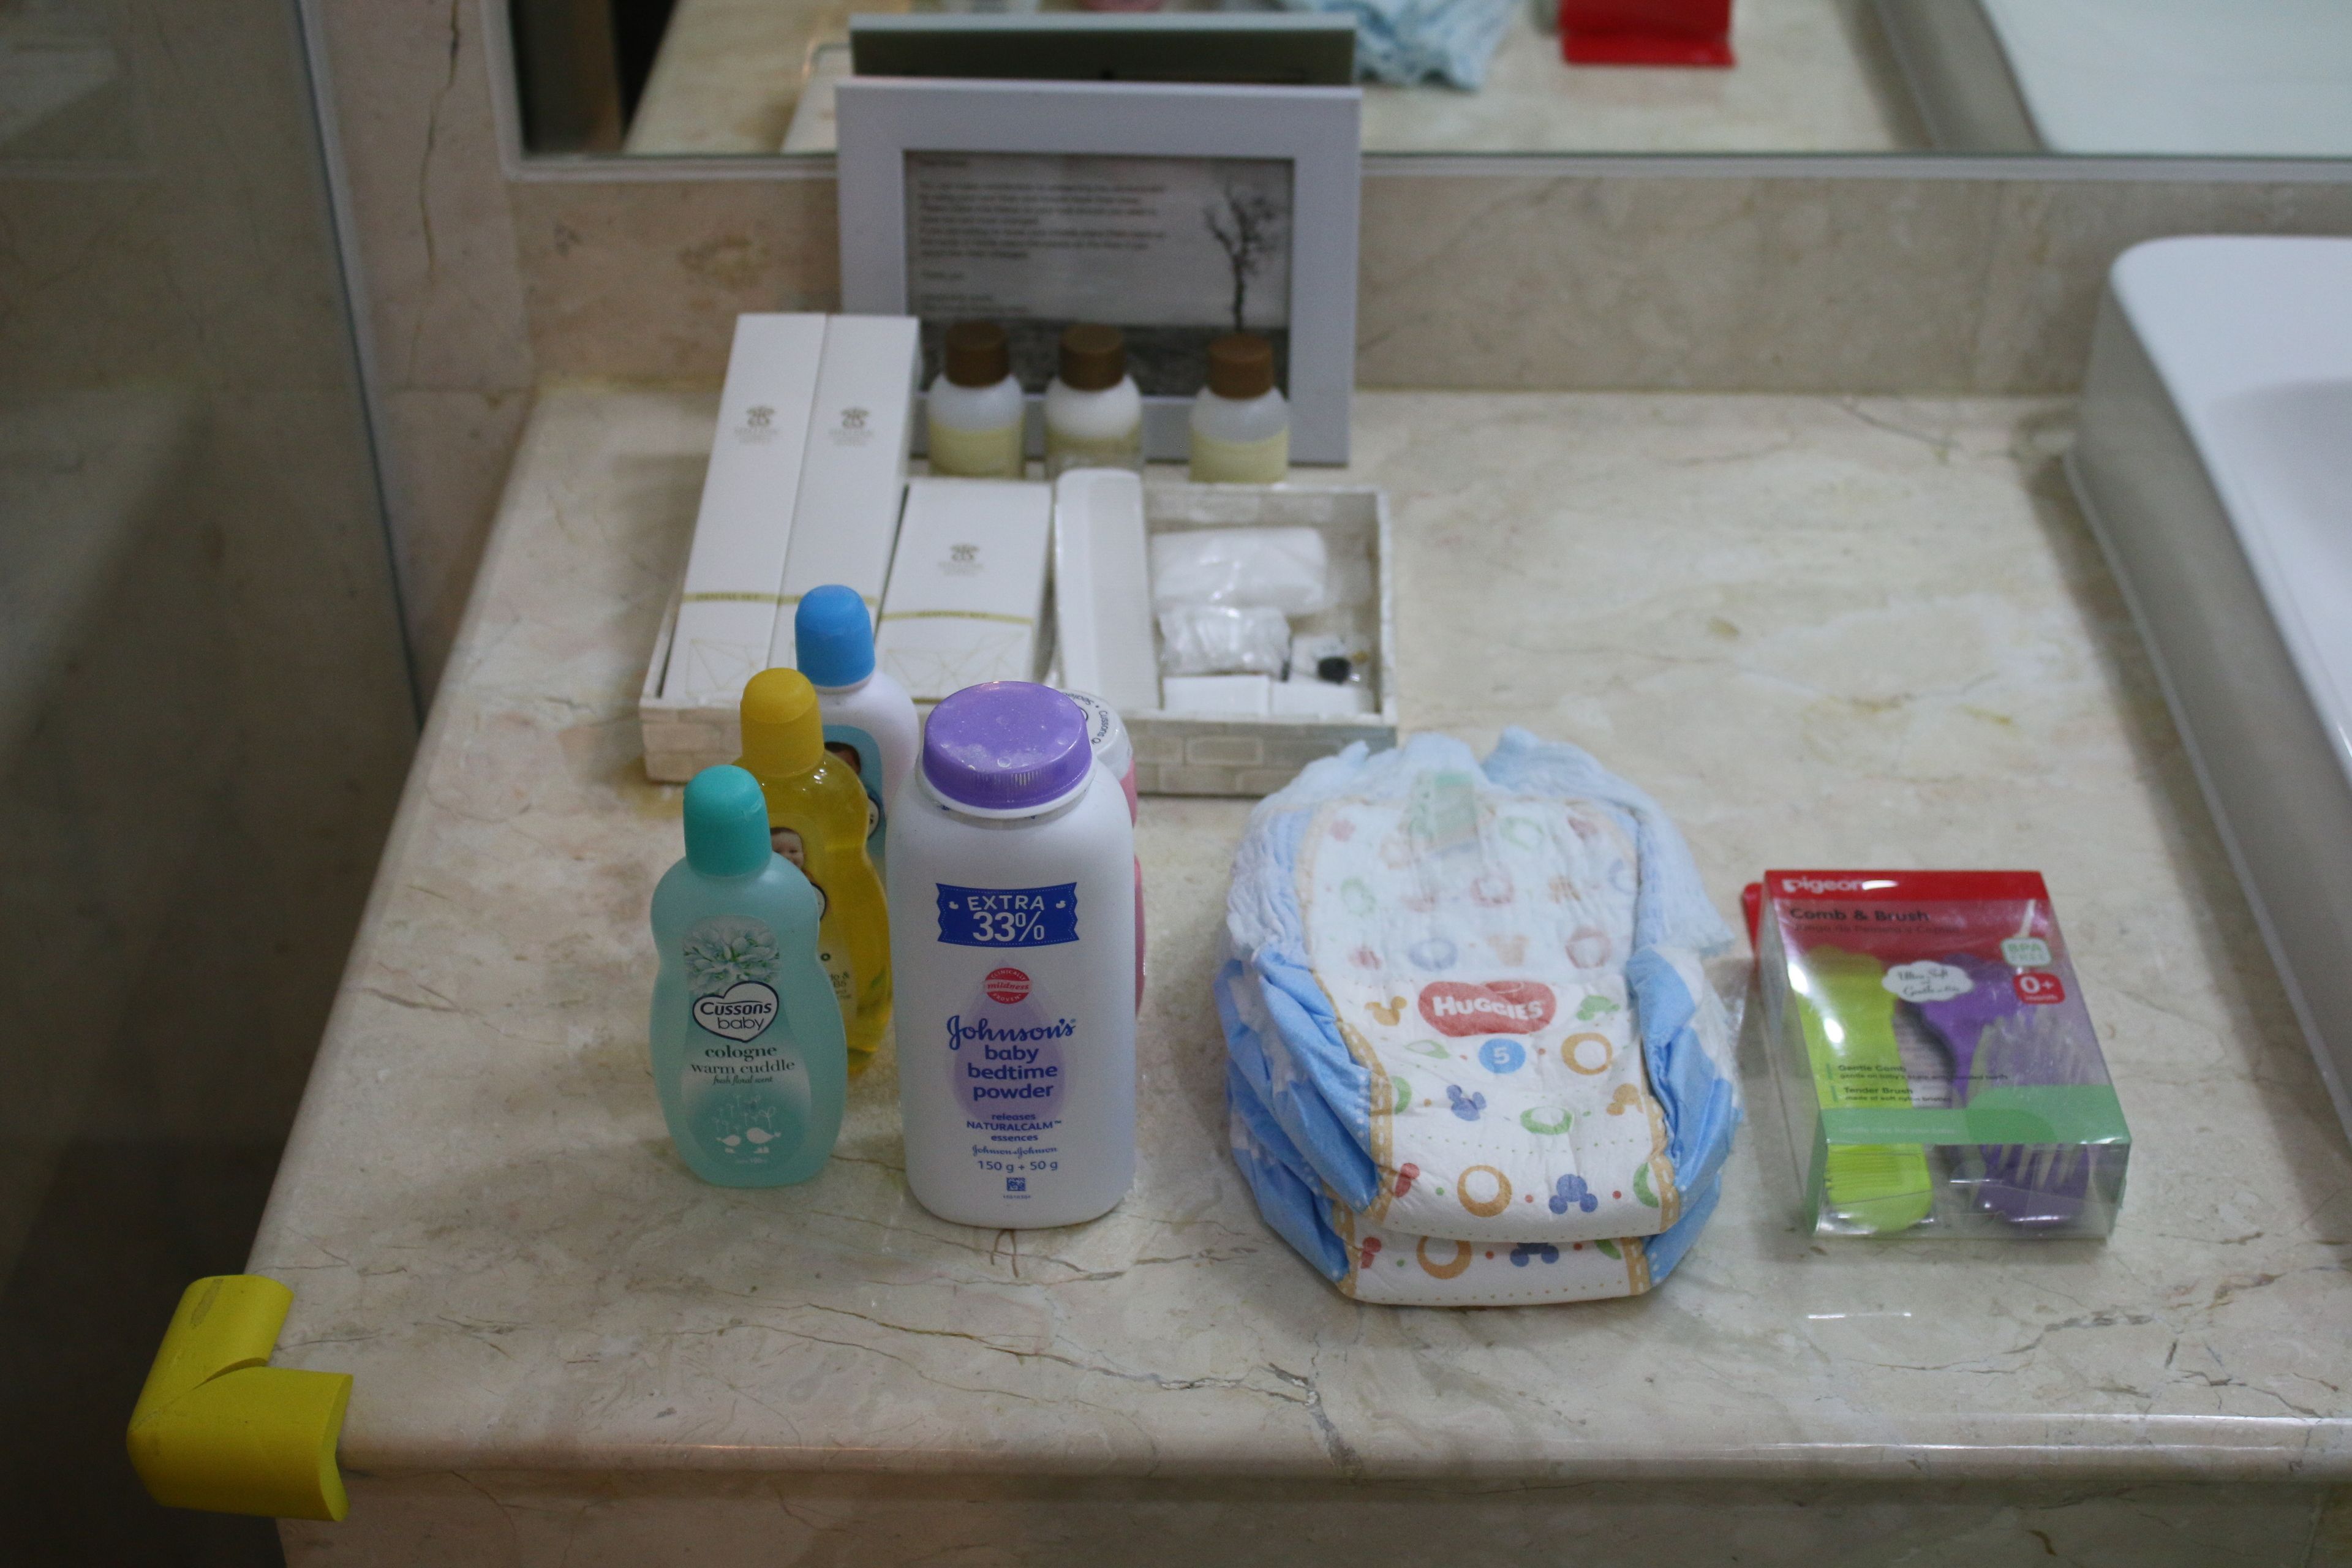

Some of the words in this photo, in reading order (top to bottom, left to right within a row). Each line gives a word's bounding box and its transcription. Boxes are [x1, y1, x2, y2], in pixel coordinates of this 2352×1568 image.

[967, 895, 1045, 911] EXTRA
[1790, 908, 1846, 919] Comb
[1854, 909, 1868, 921] &
[1874, 910, 1929, 921] Brush
[973, 911, 1045, 942] 33%
[990, 970, 1027, 980] CLINICALLY
[987, 982, 1030, 990] mildness
[2020, 976, 2054, 993] 0+
[700, 1001, 772, 1016] Cussons
[1432, 996, 1544, 1021] HUGGIES
[717, 1017, 764, 1031] baby
[947, 1015, 1076, 1050] Johnson's
[705, 1045, 777, 1061] cologne
[984, 1044, 1039, 1064] baby
[1494, 1047, 1510, 1065] 5
[691, 1063, 735, 1074] warm
[740, 1059, 796, 1074] cuddle
[968, 1063, 1058, 1080] bedtime
[713, 1076, 731, 1085] fresh
[732, 1076, 753, 1086] floral
[973, 1084, 1054, 1101] powder
[978, 1161, 1002, 1170] 150
[1006, 1164, 1014, 1173] g
[1030, 1161, 1046, 1170] 50
[1050, 1161, 1058, 1170] g
